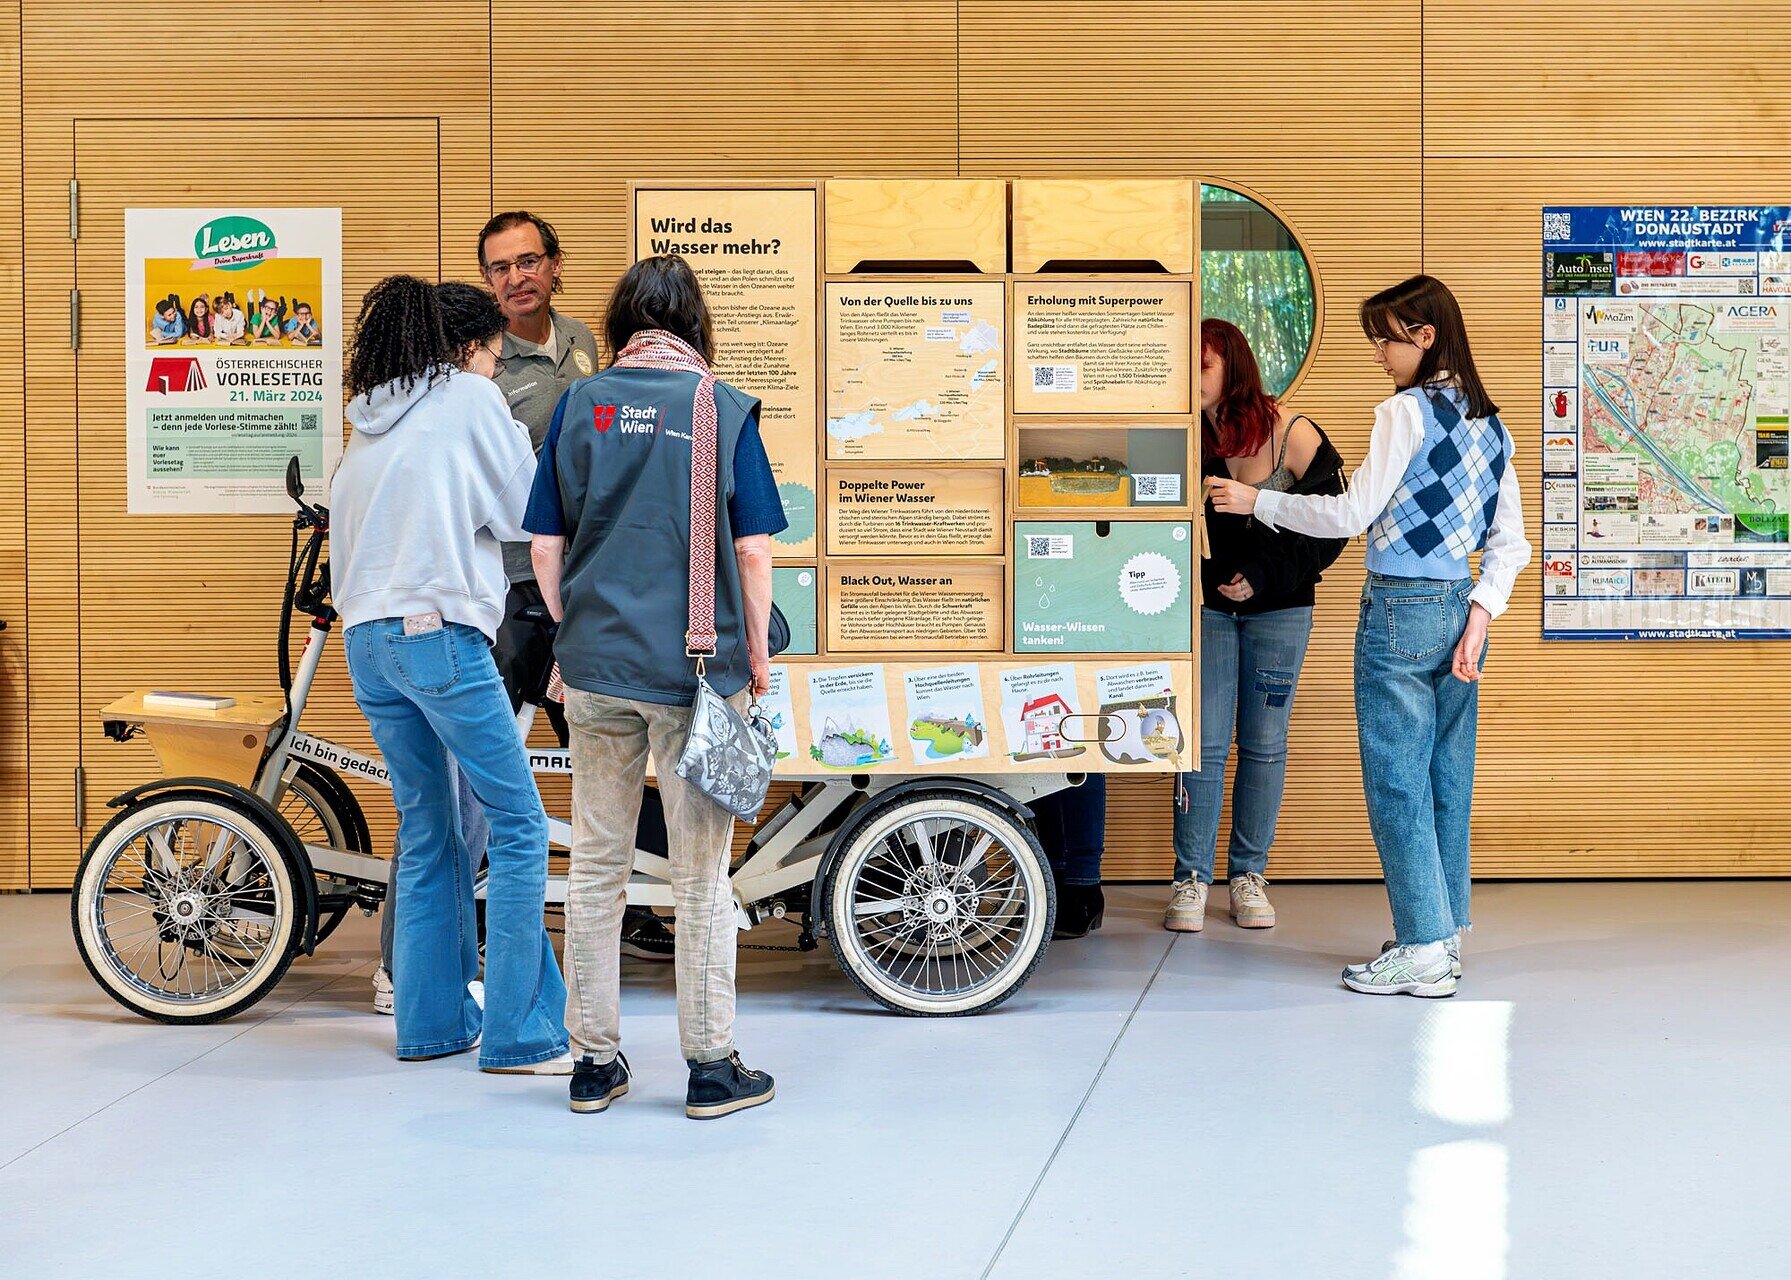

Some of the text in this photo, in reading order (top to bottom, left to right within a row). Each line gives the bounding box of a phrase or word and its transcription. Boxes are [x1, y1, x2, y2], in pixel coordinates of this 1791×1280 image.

[1621, 210, 1758, 221] WIEN 22. BEZIRK
[651, 218, 732, 233] Wird das
[1635, 224, 1744, 235] DONAUSTADT
[201, 227, 271, 255] Lesen
[651, 239, 781, 254] Wasser mehr?
[1639, 239, 1736, 248] www.stadtkarte.at
[214, 252, 264, 266] Deine Superkraft
[840, 297, 861, 306] Von
[864, 297, 882, 306] der
[884, 297, 919, 307] Quelle
[922, 297, 937, 306] bis
[1028, 296, 1163, 307] Erholung mit Superpower
[1728, 306, 1776, 316] AGERA
[1604, 313, 1633, 321] MaZim
[216, 357, 322, 369] ÖSTERREICHISCHER
[217, 373, 323, 386] VORLESETAG
[230, 390, 323, 402] 21. März 2024
[153, 413, 284, 422] Jetzt anmelden und mitmachen
[621, 406, 657, 419] Stadt
[185, 423, 202, 432] jede
[620, 420, 654, 433] Wien
[665, 429, 693, 440] Wien Kan
[839, 481, 925, 492] Doppelte Power
[839, 494, 935, 502] im Wiener Wasser
[1545, 561, 1572, 571] MDS
[1129, 571, 1146, 579] Tipp
[841, 576, 870, 585] Black
[872, 576, 895, 587] Out,
[898, 576, 937, 585] Wasser
[1023, 622, 1105, 632] Wasser-Wissen
[1639, 629, 1736, 639] www.stadtkarte.at
[1023, 635, 1064, 645] tanken!
[915, 678, 970, 688] Hochquellenleitungen
[290, 736, 311, 753] Ich
[314, 744, 337, 762] bin
